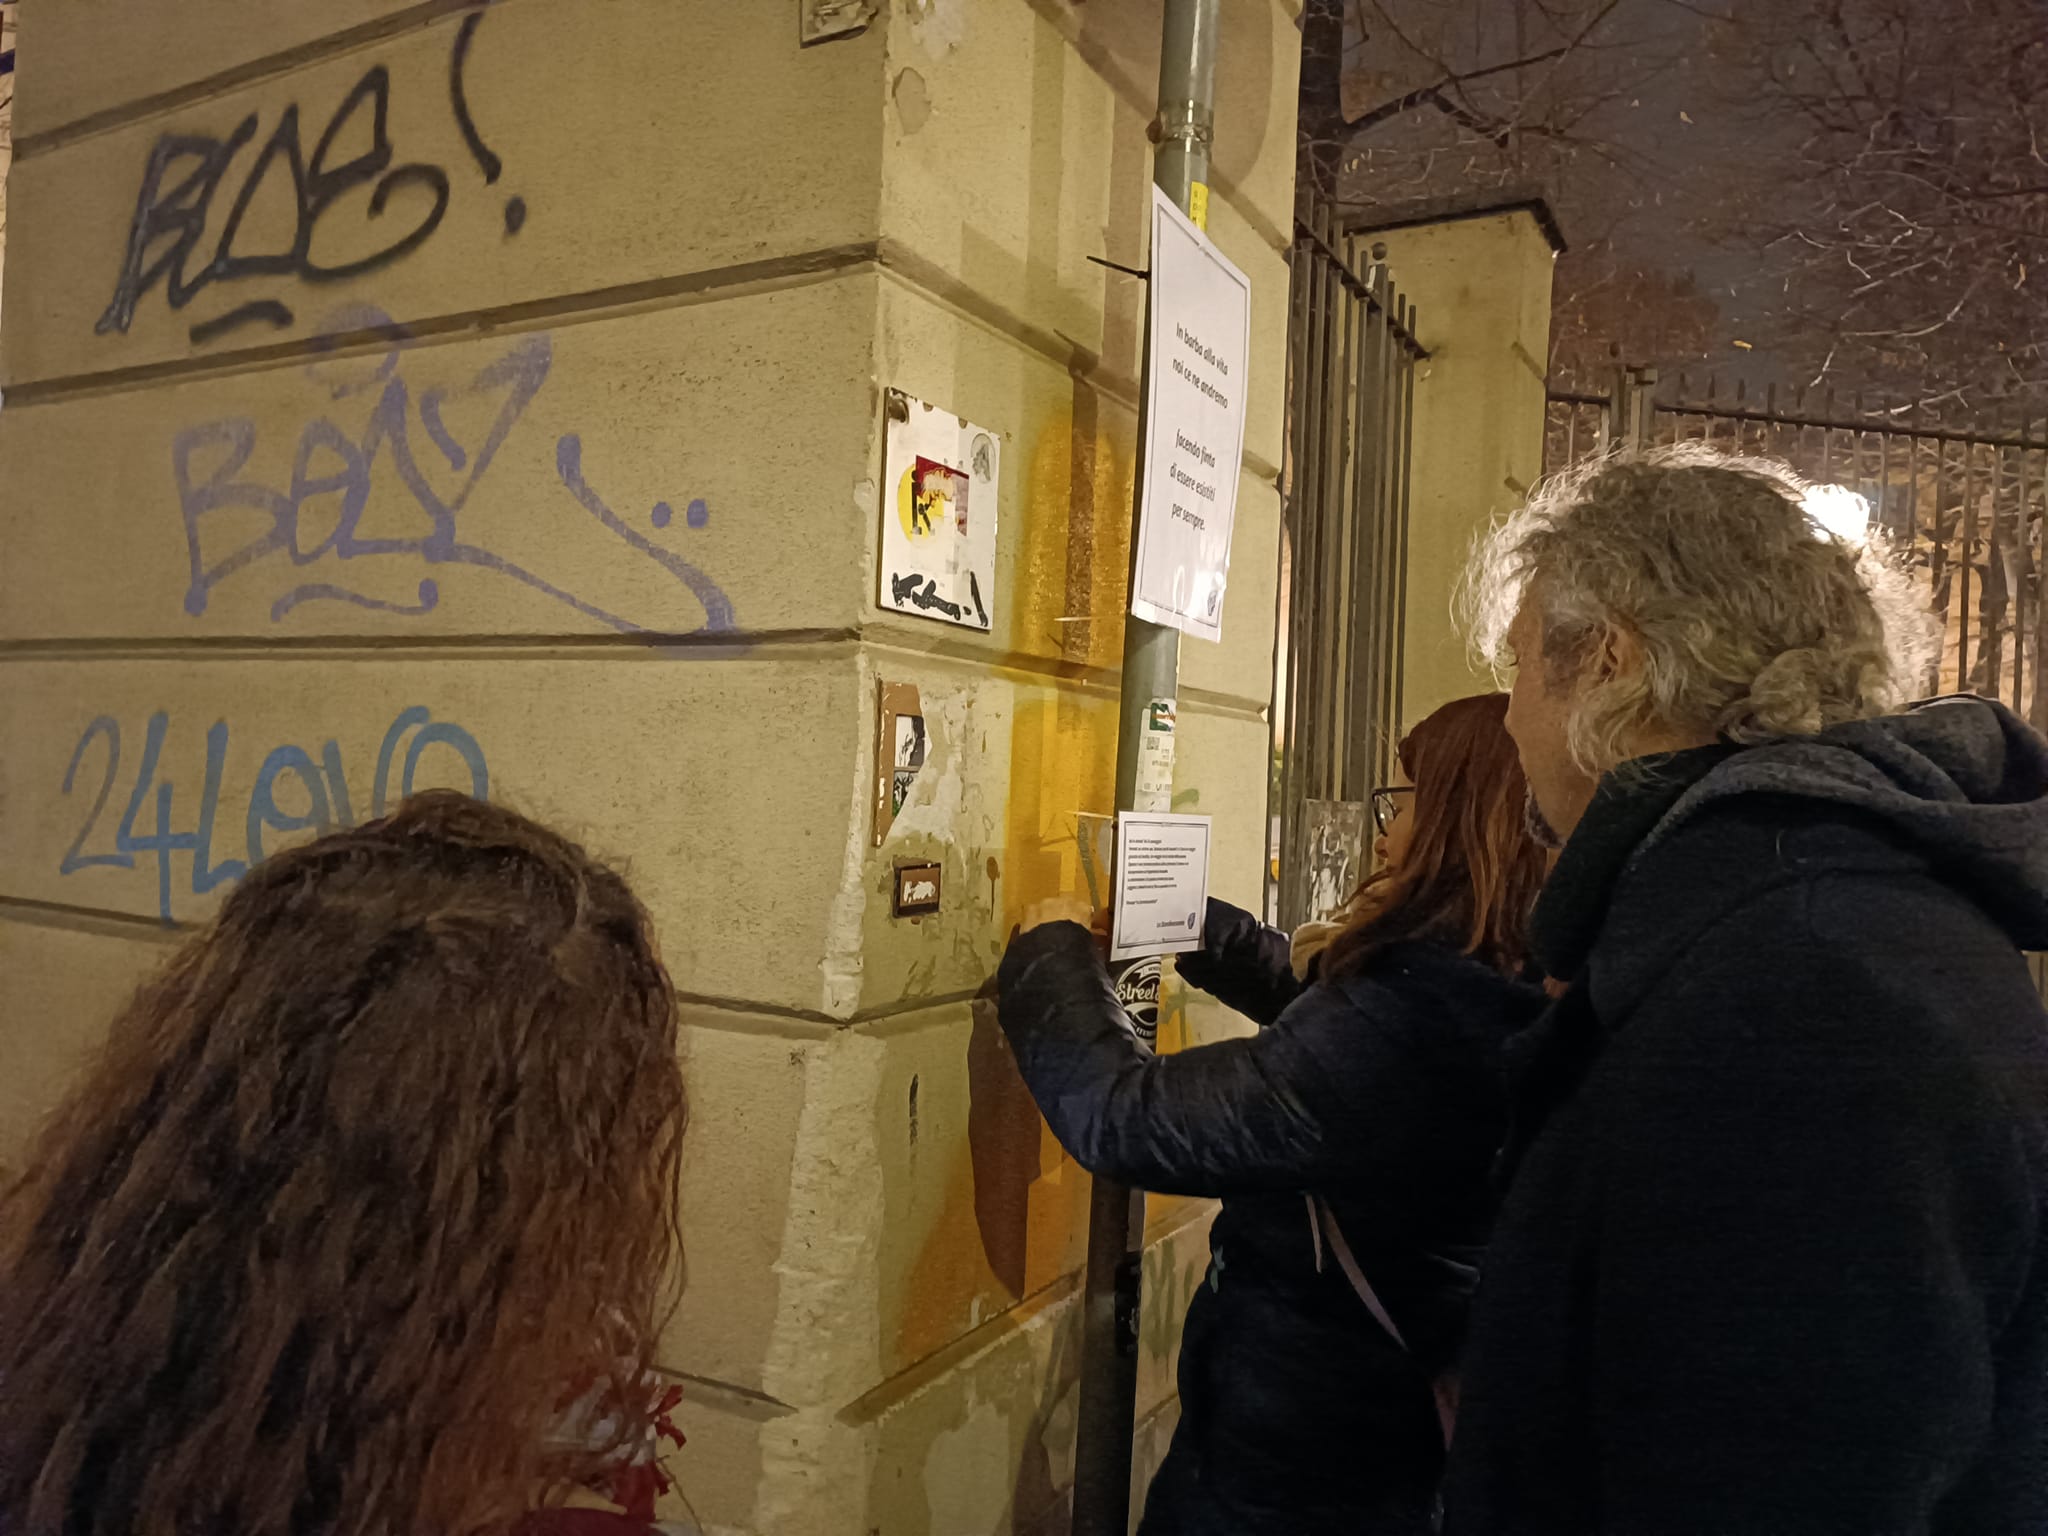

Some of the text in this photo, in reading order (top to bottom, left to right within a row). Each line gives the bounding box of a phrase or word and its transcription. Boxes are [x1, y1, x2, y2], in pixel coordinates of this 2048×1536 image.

[1176, 321, 1228, 376] In barba alla vita
[1172, 358, 1228, 409] noi ce ne andremo
[1175, 428, 1216, 468] facendo finta
[1169, 461, 1177, 479] di
[1176, 470, 1196, 491] essere
[1171, 503, 1205, 531] per sempre.
